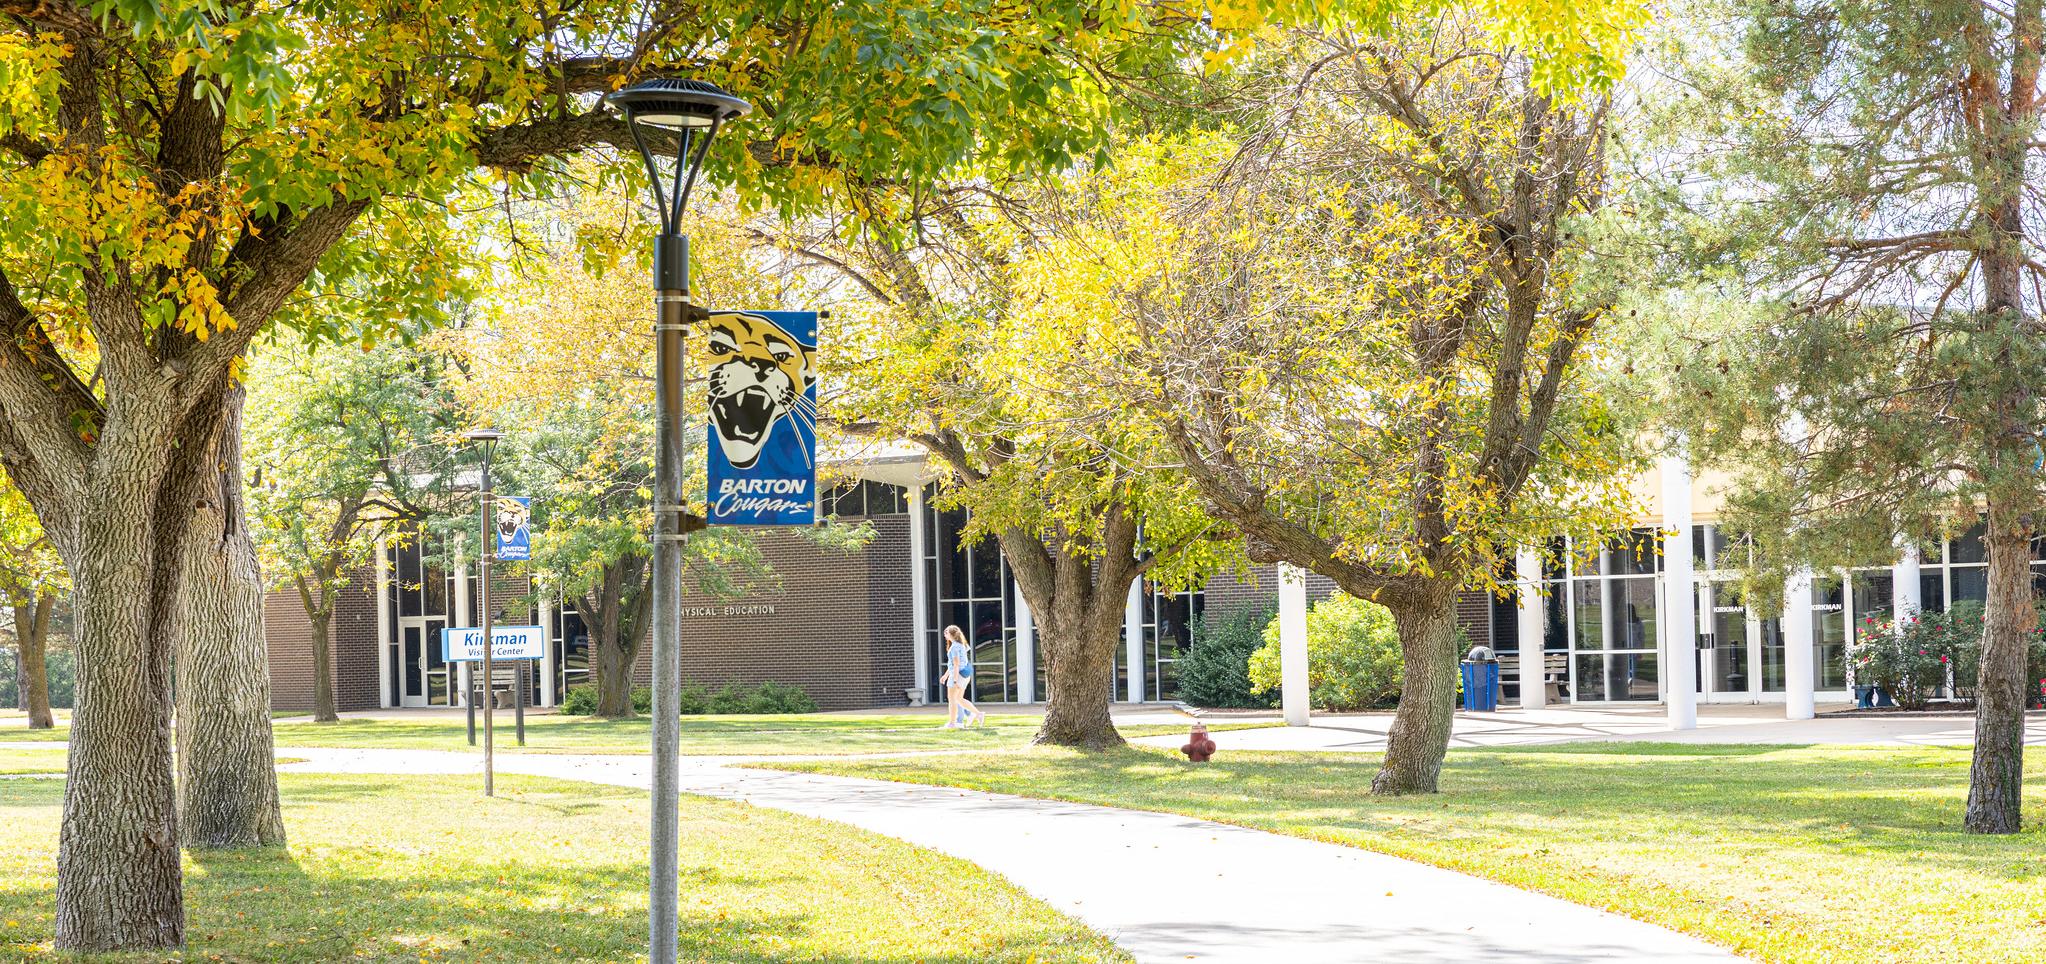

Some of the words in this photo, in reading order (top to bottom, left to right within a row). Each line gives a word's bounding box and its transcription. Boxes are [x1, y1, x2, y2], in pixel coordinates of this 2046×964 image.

[719, 479, 807, 494] BARTON
[715, 492, 807, 518] Cougars
[680, 607, 717, 617] HYSICAL
[724, 605, 775, 616] EDUCATION
[1811, 603, 1842, 611] KIRKMAN
[468, 648, 495, 656] Visir
[497, 647, 524, 656] Center
